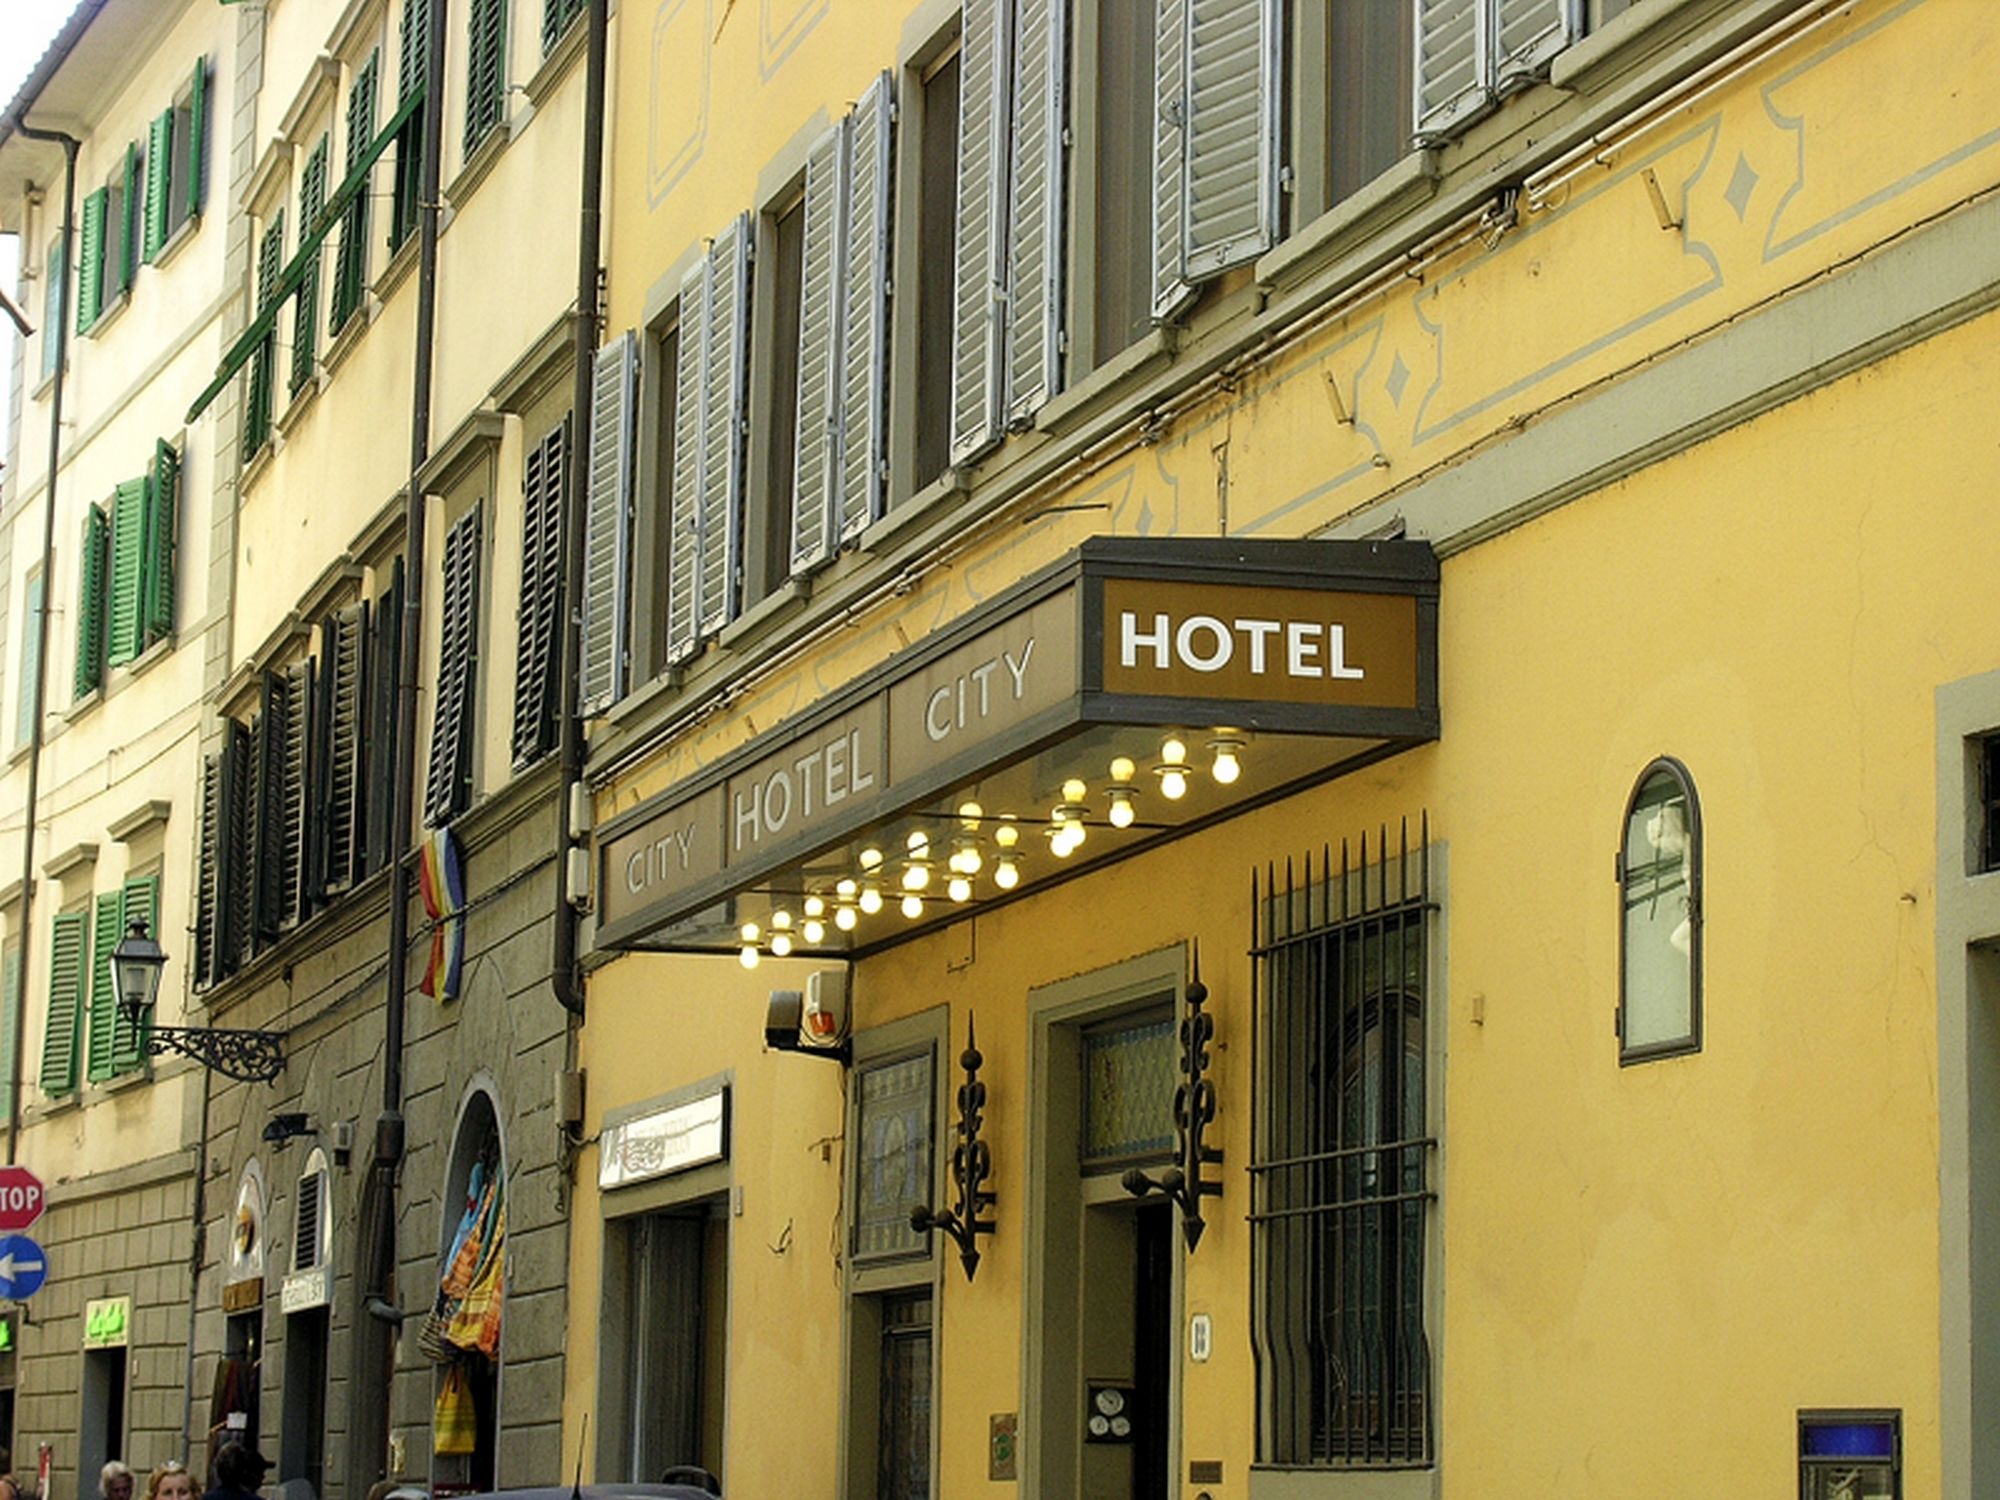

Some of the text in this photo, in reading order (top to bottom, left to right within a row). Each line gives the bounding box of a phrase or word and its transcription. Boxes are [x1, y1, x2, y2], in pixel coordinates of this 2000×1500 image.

[1121, 612, 1364, 679] HOTEL
[626, 637, 1035, 895] CITY HOTEL CITY
